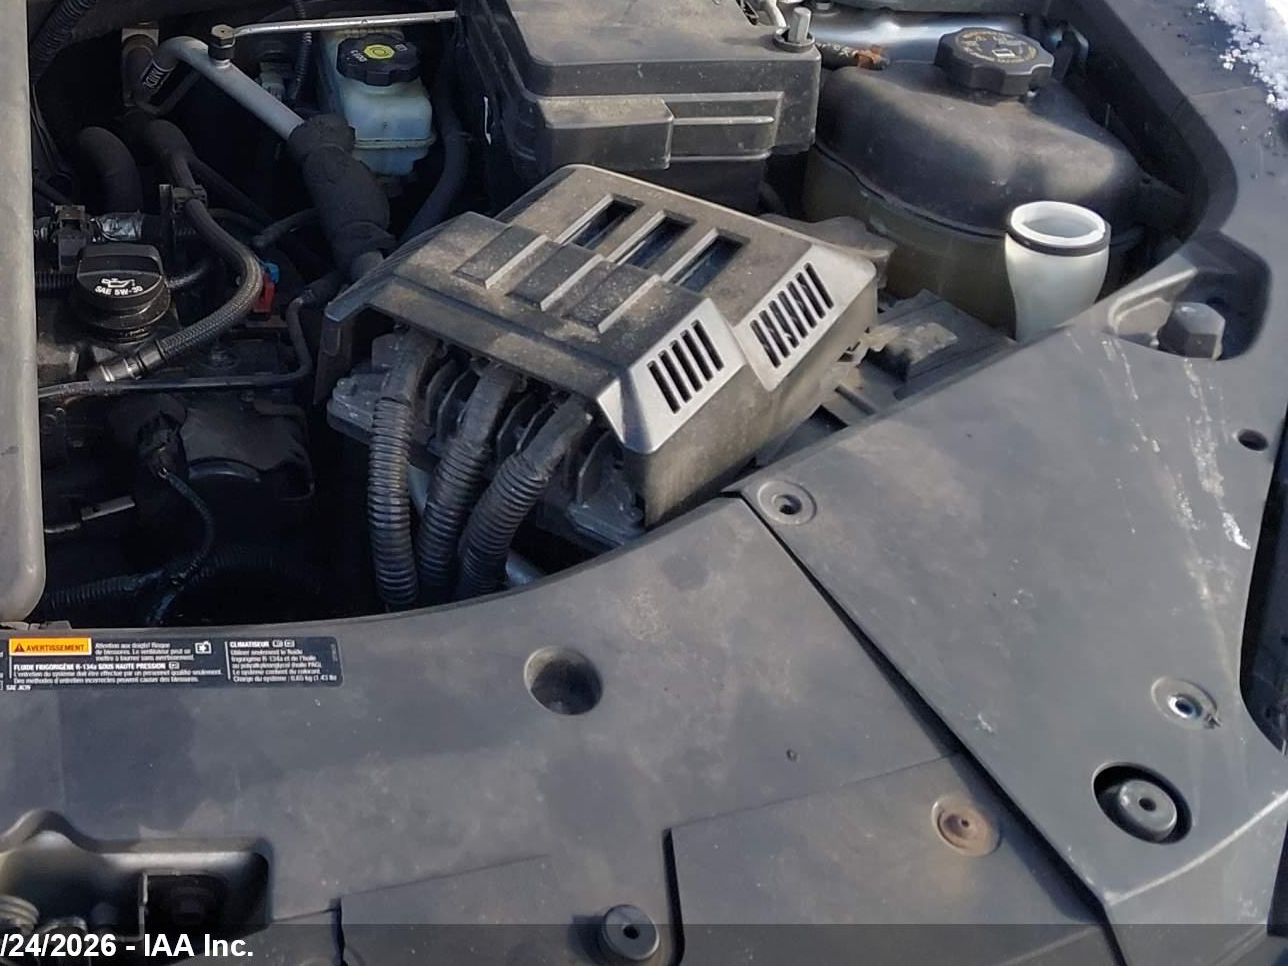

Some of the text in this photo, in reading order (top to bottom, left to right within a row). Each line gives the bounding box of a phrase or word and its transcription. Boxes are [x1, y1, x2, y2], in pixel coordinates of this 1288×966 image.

[95, 286, 143, 295] SAE 5W-30
[26, 644, 84, 653] AVERTISSEMENT
